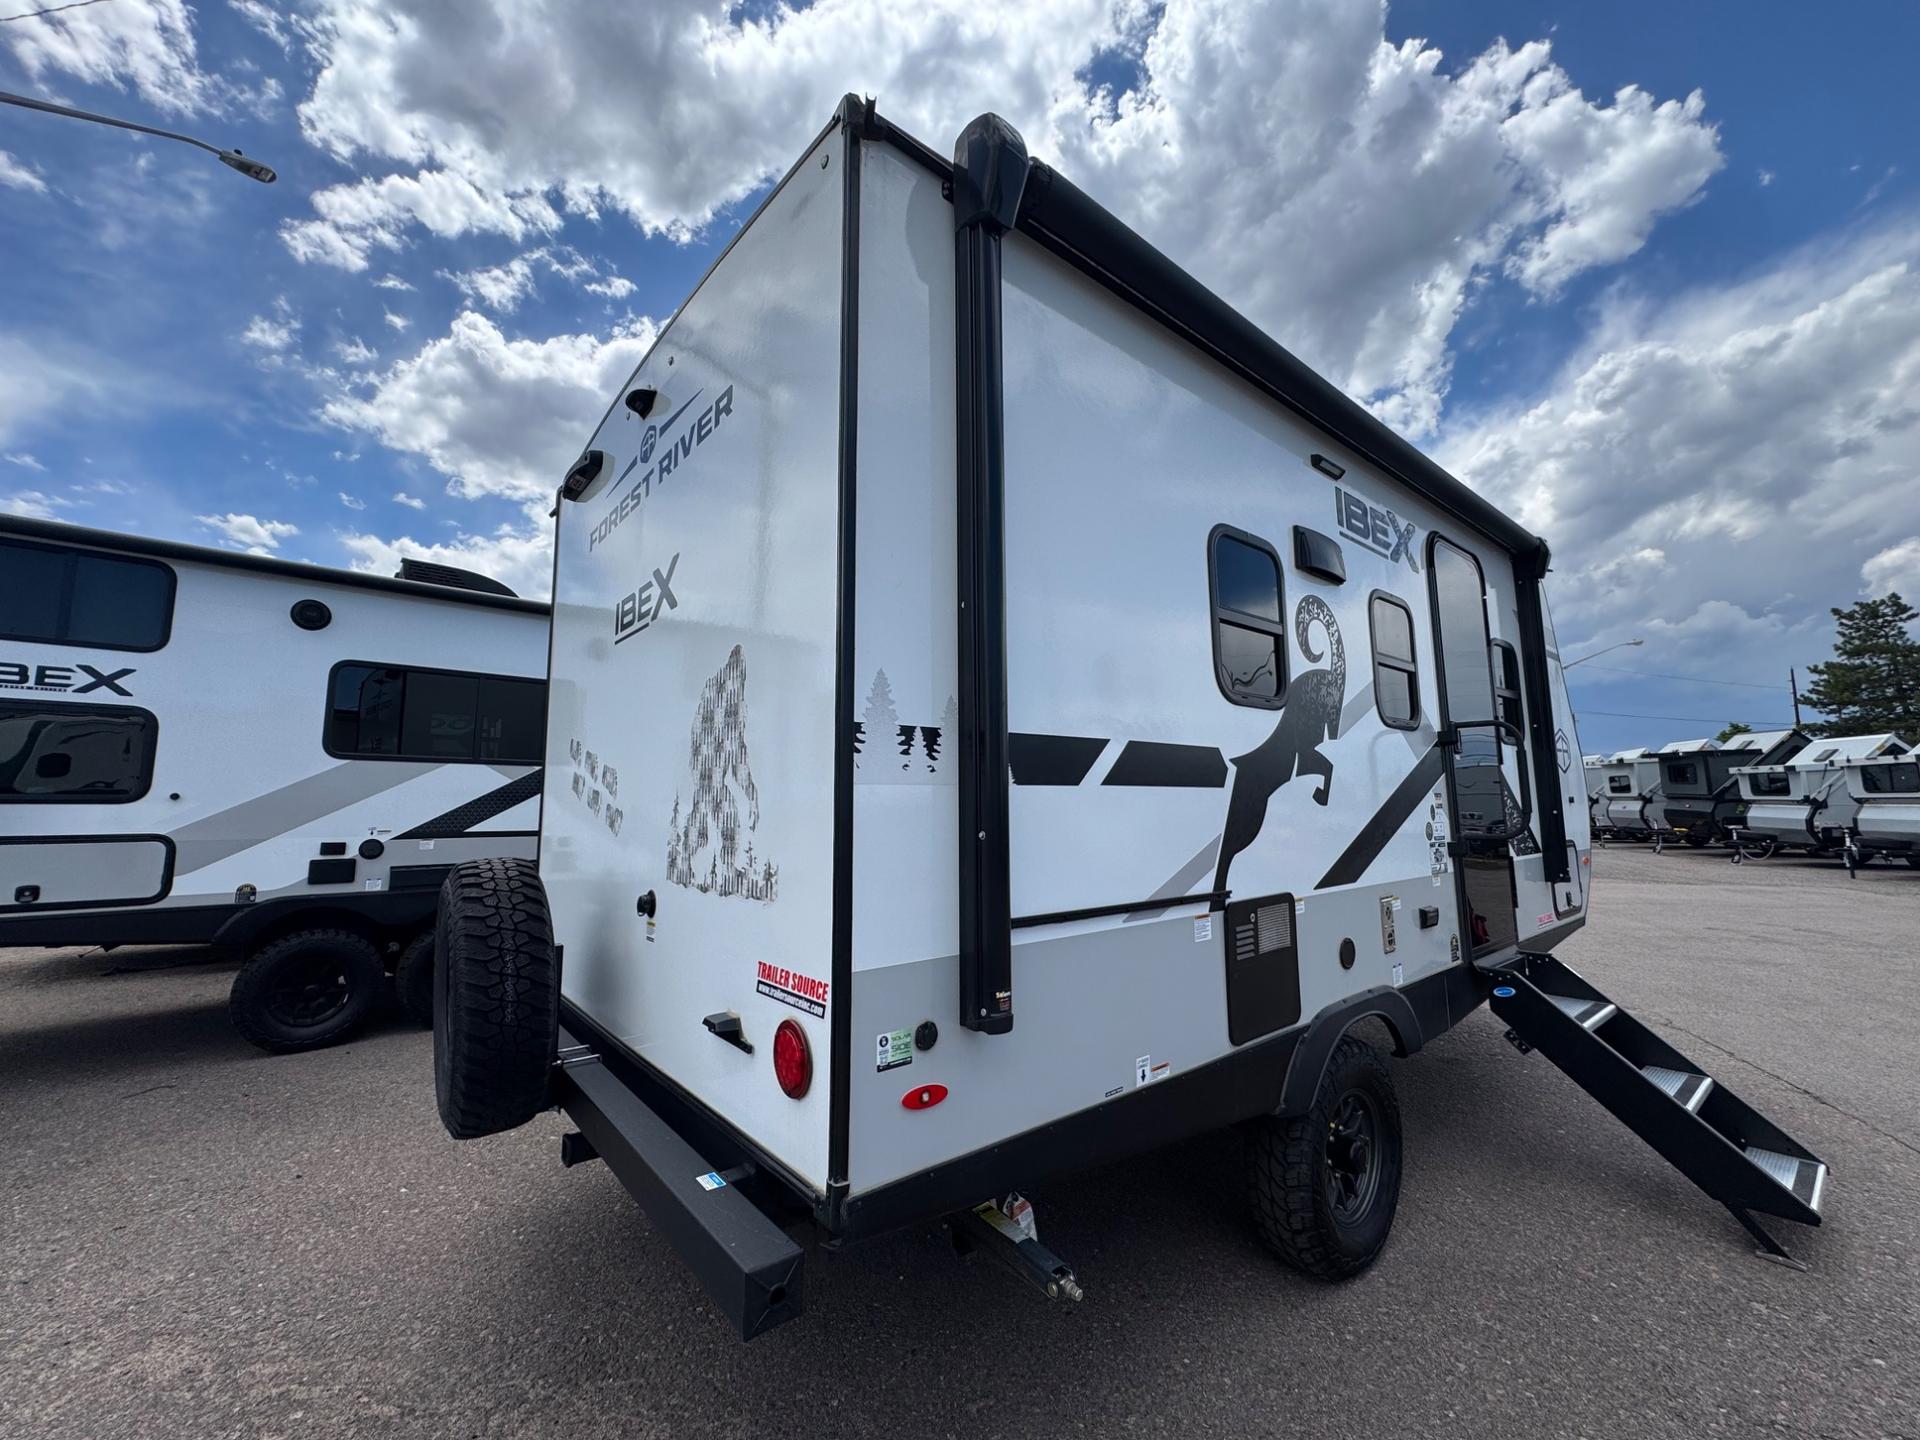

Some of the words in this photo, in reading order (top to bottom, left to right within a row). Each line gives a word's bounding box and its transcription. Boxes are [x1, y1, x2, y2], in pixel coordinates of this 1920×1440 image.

[590, 468, 654, 552] FOREST
[658, 385, 734, 485] RIVER
[1335, 486, 1419, 574] IBEX
[615, 552, 680, 636] IBEX
[757, 961, 791, 989] TRAILER
[791, 973, 829, 1003] SOURCE
